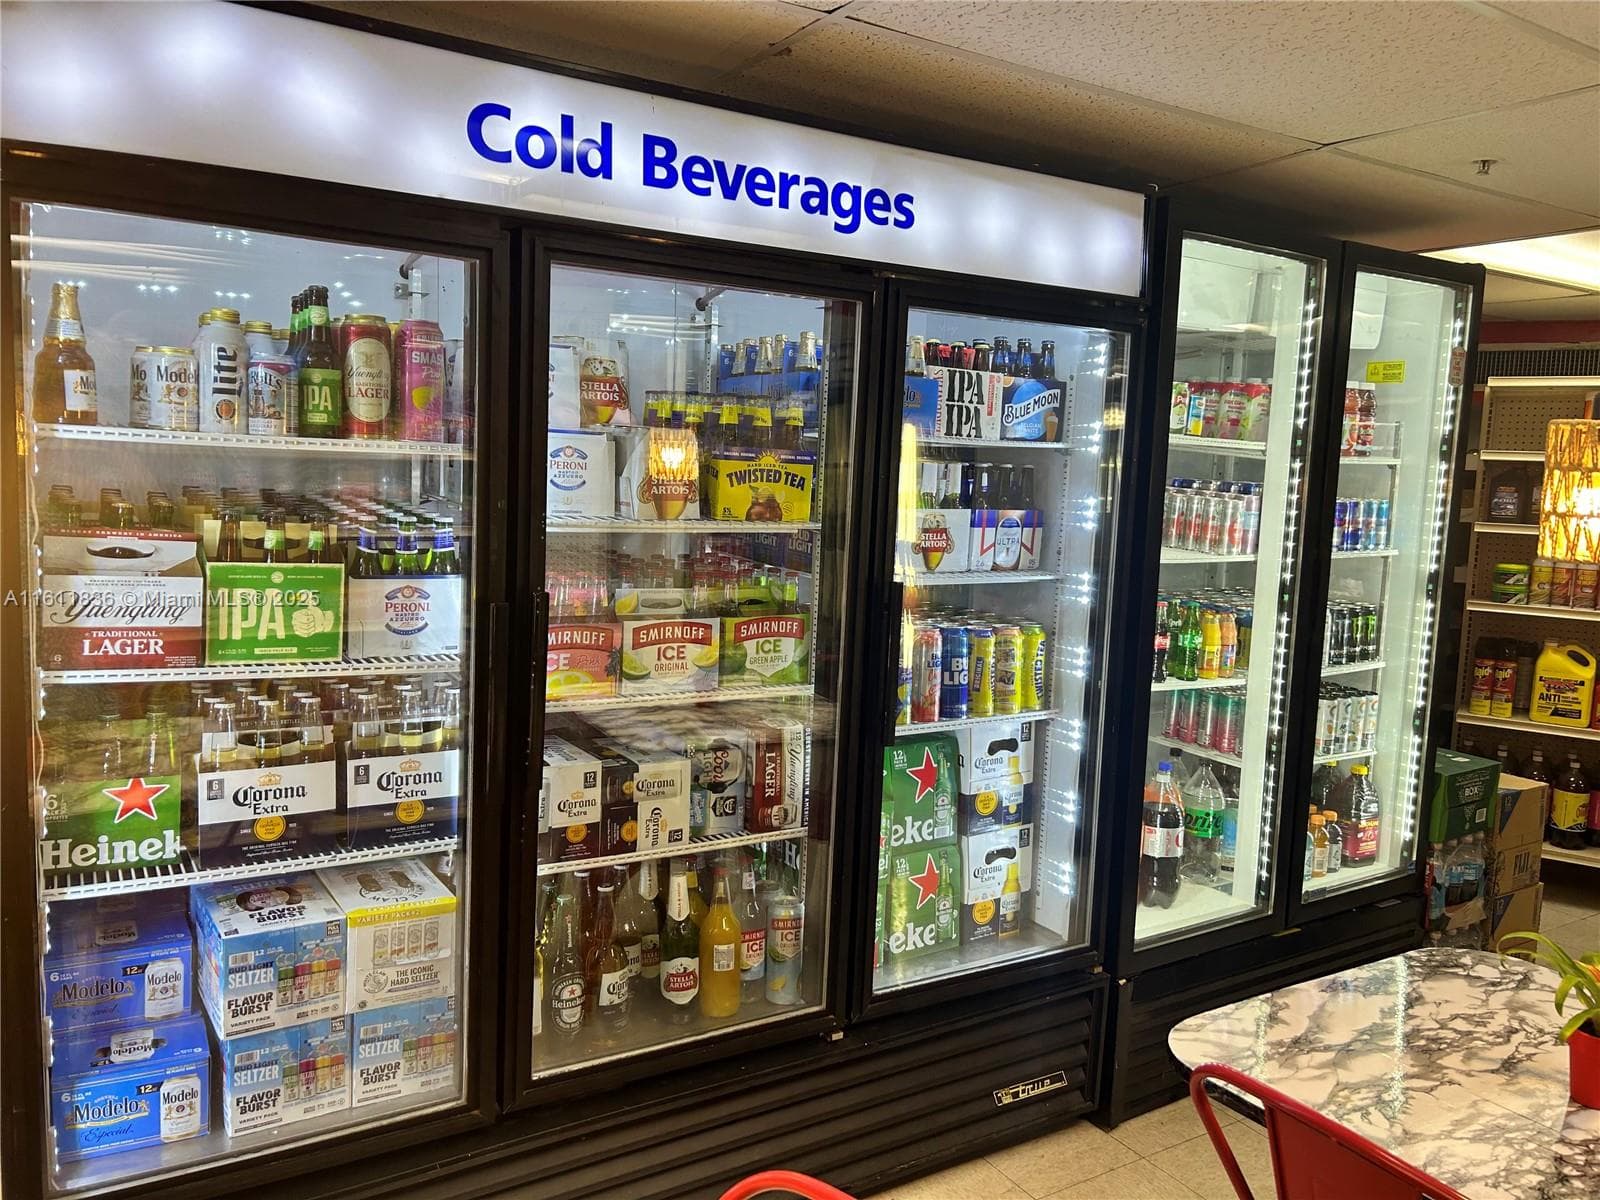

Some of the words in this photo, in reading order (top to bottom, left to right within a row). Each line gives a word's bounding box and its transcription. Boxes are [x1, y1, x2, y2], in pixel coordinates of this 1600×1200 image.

[466, 102, 613, 181] Cold
[642, 133, 916, 235] Beverages
[348, 385, 389, 400] LAGER
[581, 381, 619, 391] STELLA
[945, 369, 985, 405] IPA
[303, 385, 332, 411] IPA
[580, 391, 619, 401] ARTOIS
[1003, 403, 1031, 425] BLUE
[1031, 392, 1059, 412] MOON
[944, 403, 983, 438] IPA
[550, 460, 587, 470] PERONI
[726, 468, 782, 488] TWISTED
[784, 472, 805, 491] TEA
[651, 485, 689, 495] ARTOIS
[788, 538, 812, 554] LIGHT
[920, 540, 947, 548] ARTOIS
[50, 590, 192, 625] Yuengling
[219, 587, 285, 640] IPA
[384, 601, 432, 613] PERONI
[639, 626, 705, 643] SMIRNOFF
[741, 621, 798, 637] SMIRNOFF
[82, 638, 165, 656] LAGER
[656, 645, 687, 661] ICE
[755, 639, 782, 655] ICE
[654, 662, 688, 672] ORIGINAL
[749, 656, 768, 665] GREEN
[893, 750, 903, 759] 12
[974, 756, 1004, 770] Corona
[359, 766, 365, 776] 6
[586, 771, 594, 782] 12
[764, 752, 775, 798] LAGER
[212, 780, 219, 790] 6
[377, 771, 443, 792] Corona
[636, 778, 675, 792] Corona
[232, 785, 307, 808] Corona
[395, 787, 427, 799] Extra
[646, 789, 666, 797] Extra
[1464, 787, 1480, 797] BOX
[45, 794, 58, 810] 6
[557, 798, 597, 813] Corona
[253, 803, 289, 816] Extra
[567, 809, 588, 818] Extra
[651, 807, 663, 847] Corona
[895, 858, 904, 868] 12
[1513, 851, 1531, 876] FIJI
[973, 865, 1002, 879] Corona
[249, 905, 307, 919] FLAVOR
[256, 910, 306, 923] BURST
[358, 912, 390, 923] VARIETY
[780, 931, 800, 941] ICE
[746, 942, 763, 953] ICE
[228, 965, 249, 974] BUD
[250, 961, 274, 972] LIGHT
[396, 968, 409, 977] THE
[410, 964, 434, 976] ICONIC
[50, 972, 60, 982] 6
[148, 971, 182, 986] Modelo
[228, 968, 274, 989] SELTZER
[390, 977, 410, 987] HARD
[411, 971, 439, 983] SELTZER
[669, 974, 694, 983] STELLA
[669, 980, 694, 988] ARTOIS
[62, 978, 125, 1001] Modelo
[227, 992, 274, 1010] FLAVOR
[231, 1003, 271, 1018] BURST
[230, 1018, 255, 1027] VARIETY
[379, 1033, 400, 1042] LIGHT
[359, 1039, 400, 1058] SELTZER
[254, 1059, 279, 1069] LIGHT
[360, 1062, 401, 1078] FLAVOR
[234, 1065, 279, 1087] SELTZER
[362, 1071, 398, 1086] BURST
[139, 1085, 152, 1093] 12
[362, 1087, 383, 1095] VARIETY
[61, 1093, 71, 1102] 6
[162, 1088, 199, 1105] Modelo
[236, 1088, 281, 1106] FLAVOR
[74, 1097, 139, 1123] Modelo
[239, 1098, 278, 1115] BURST
[239, 1114, 262, 1124] VARIETY
[81, 1124, 134, 1142] Especial
